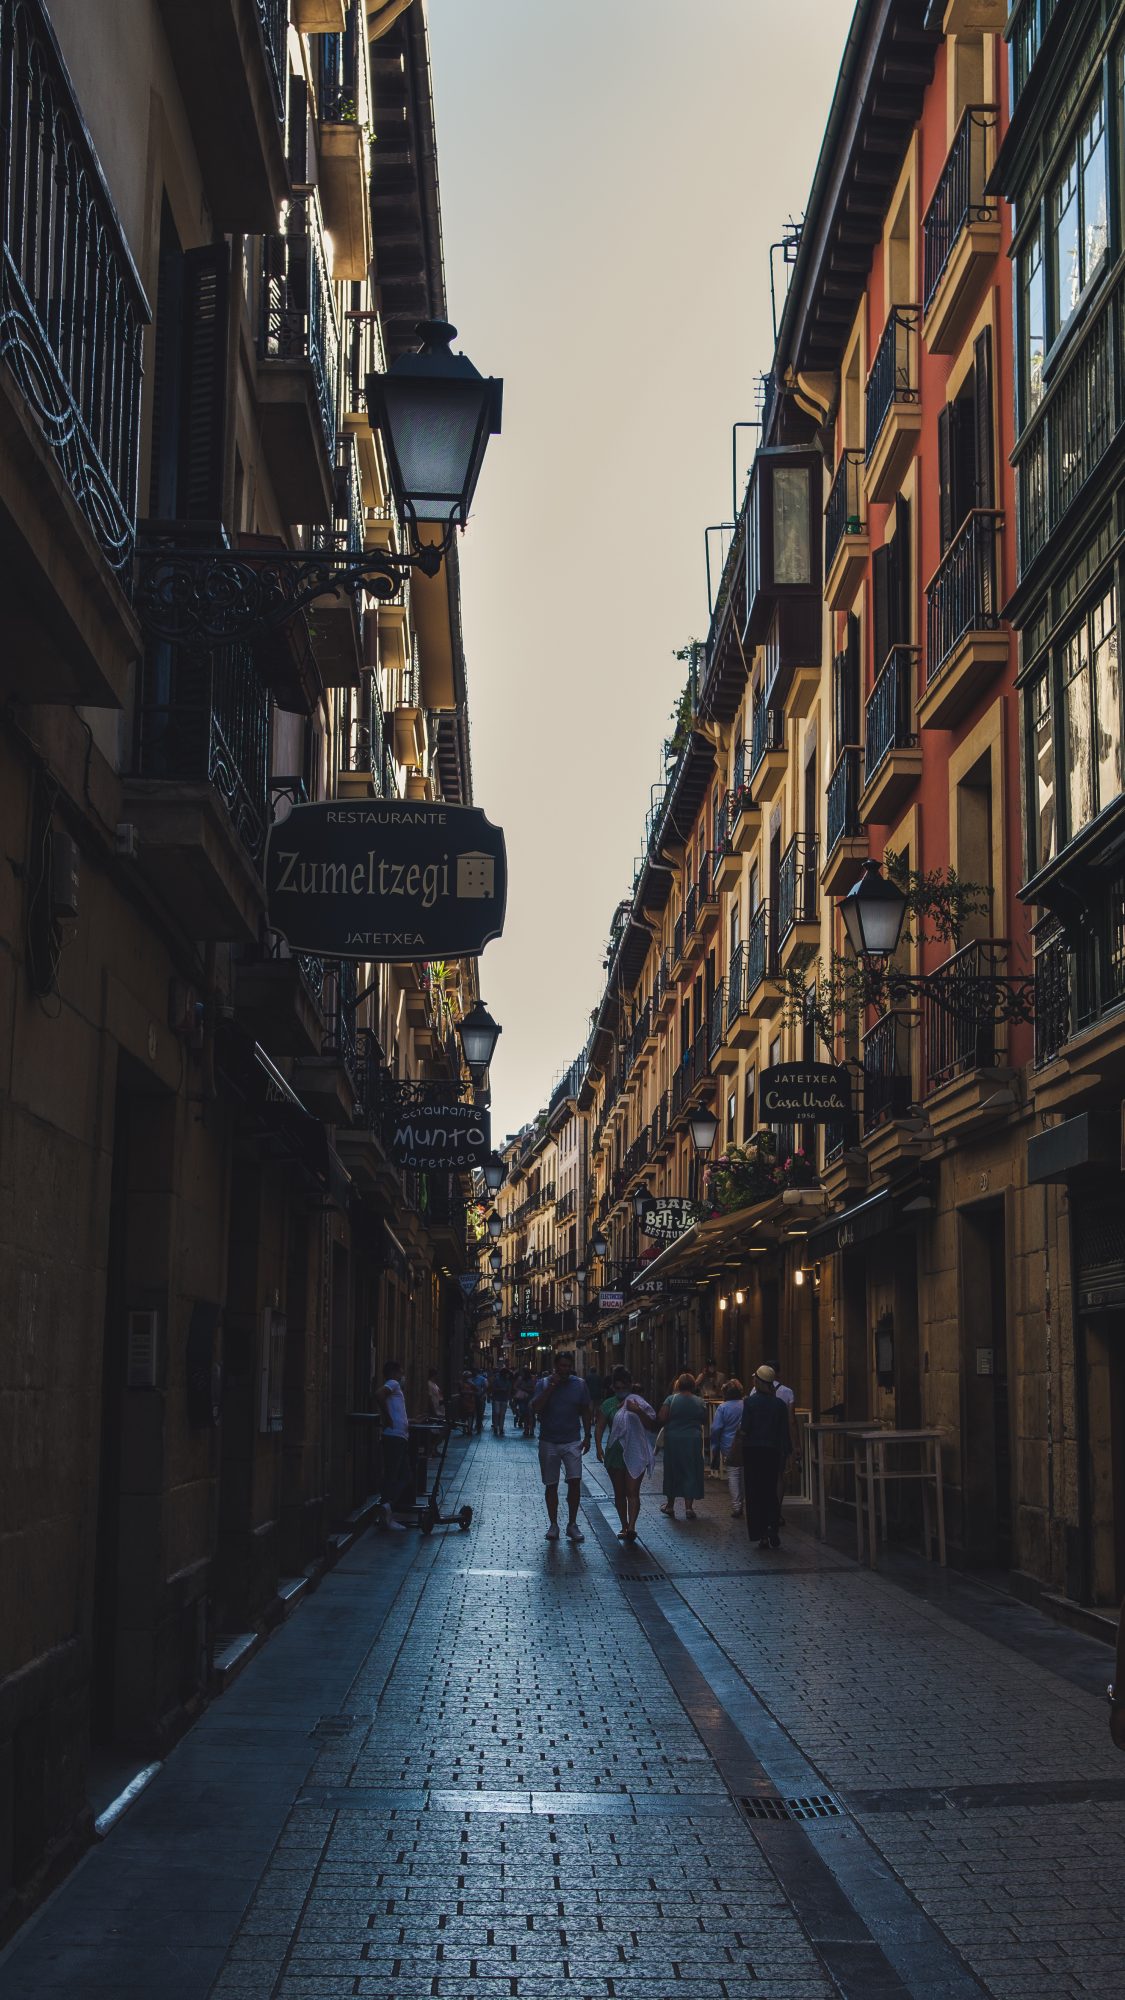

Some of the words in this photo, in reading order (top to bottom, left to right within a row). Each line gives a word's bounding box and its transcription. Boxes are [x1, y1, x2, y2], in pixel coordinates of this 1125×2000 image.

[326, 811, 448, 825] RESTAURANTE
[275, 850, 450, 907] Zumeltzegi
[344, 931, 425, 945] JATETXEA
[774, 1075, 837, 1084] JATETXEA
[765, 1090, 801, 1110] Casa
[802, 1091, 846, 1109] Urola
[655, 1198, 693, 1211] BAR
